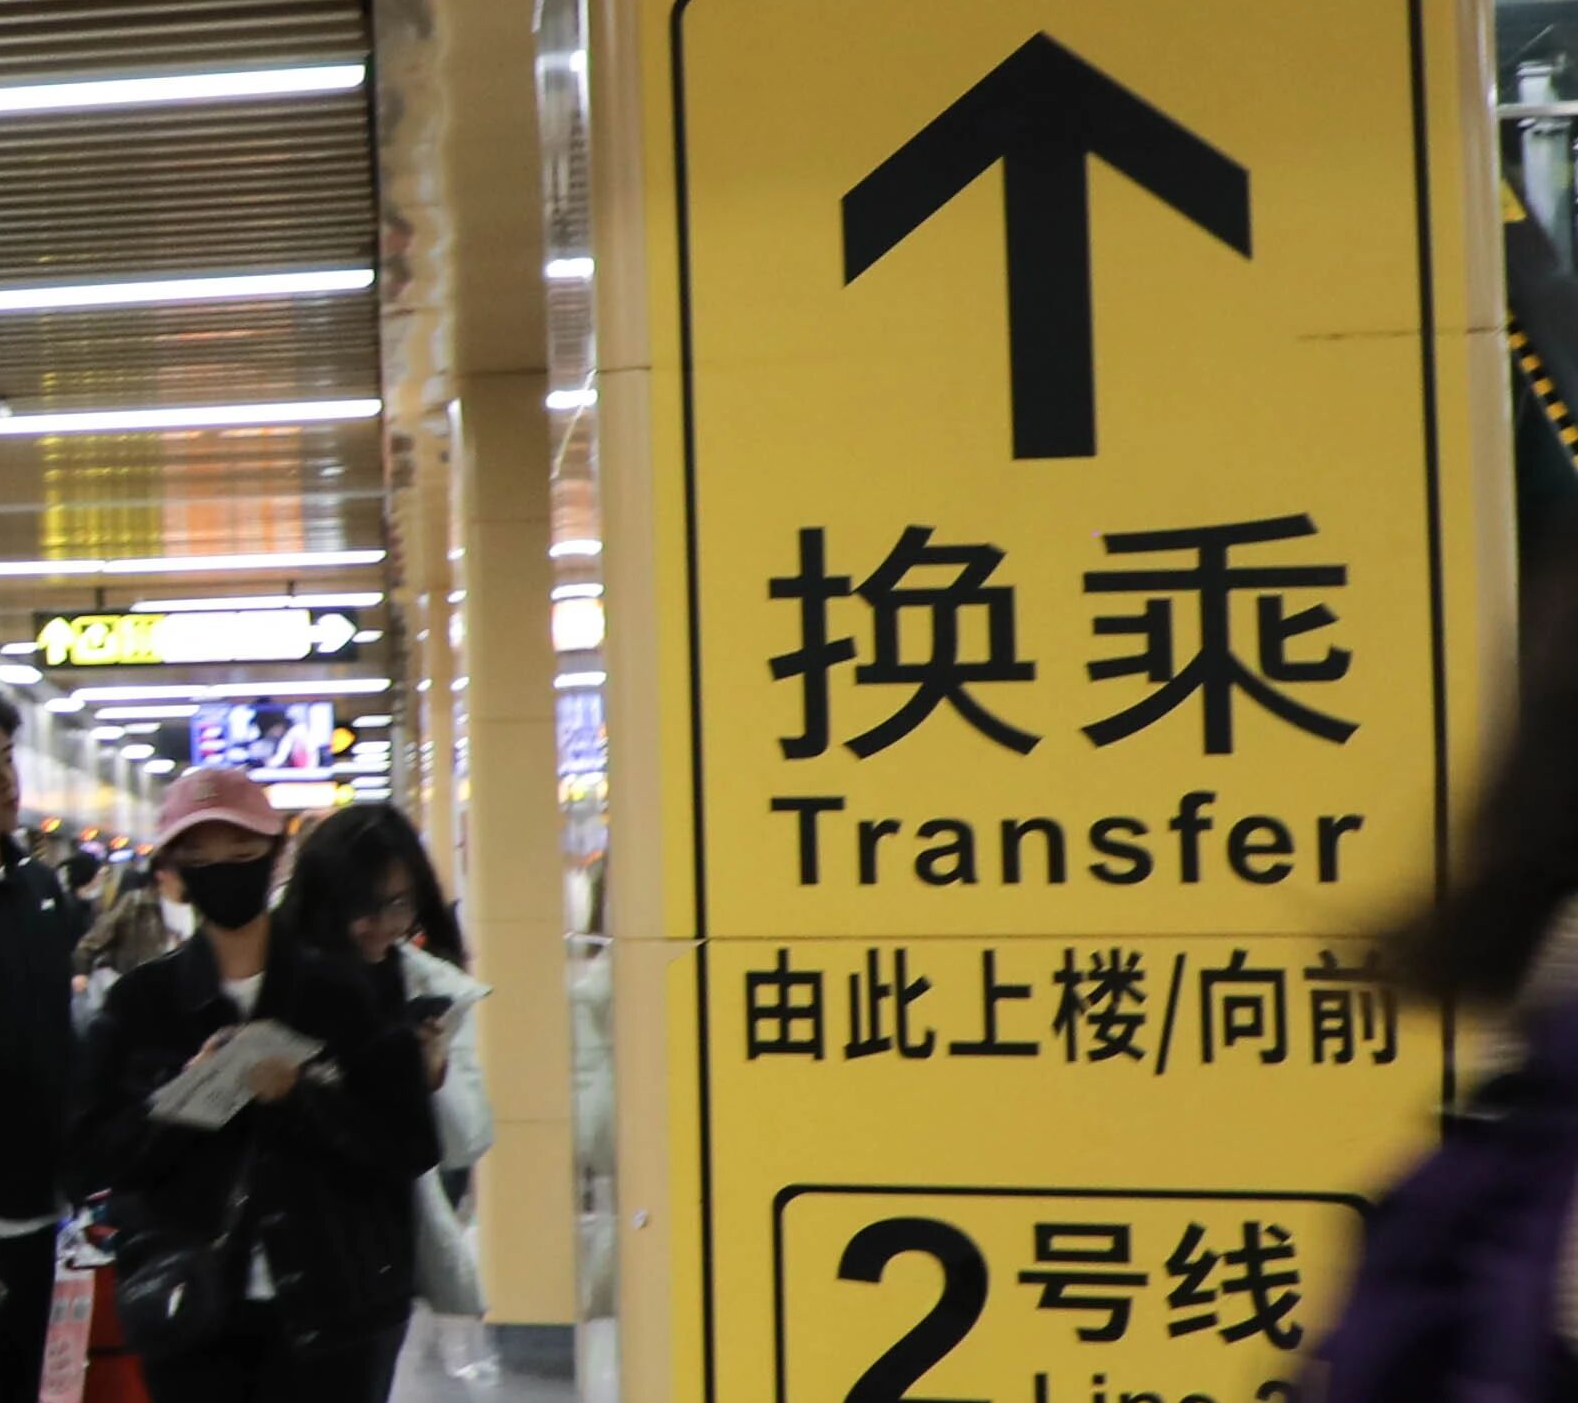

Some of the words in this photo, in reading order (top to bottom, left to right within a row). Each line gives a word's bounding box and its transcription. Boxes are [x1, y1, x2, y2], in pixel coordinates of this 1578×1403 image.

[768, 513, 1361, 760] 换乘
[770, 791, 1365, 886] Transfer
[745, 947, 1399, 1076] 由此上楼/向前
[1017, 1220, 1304, 1352] 号线
